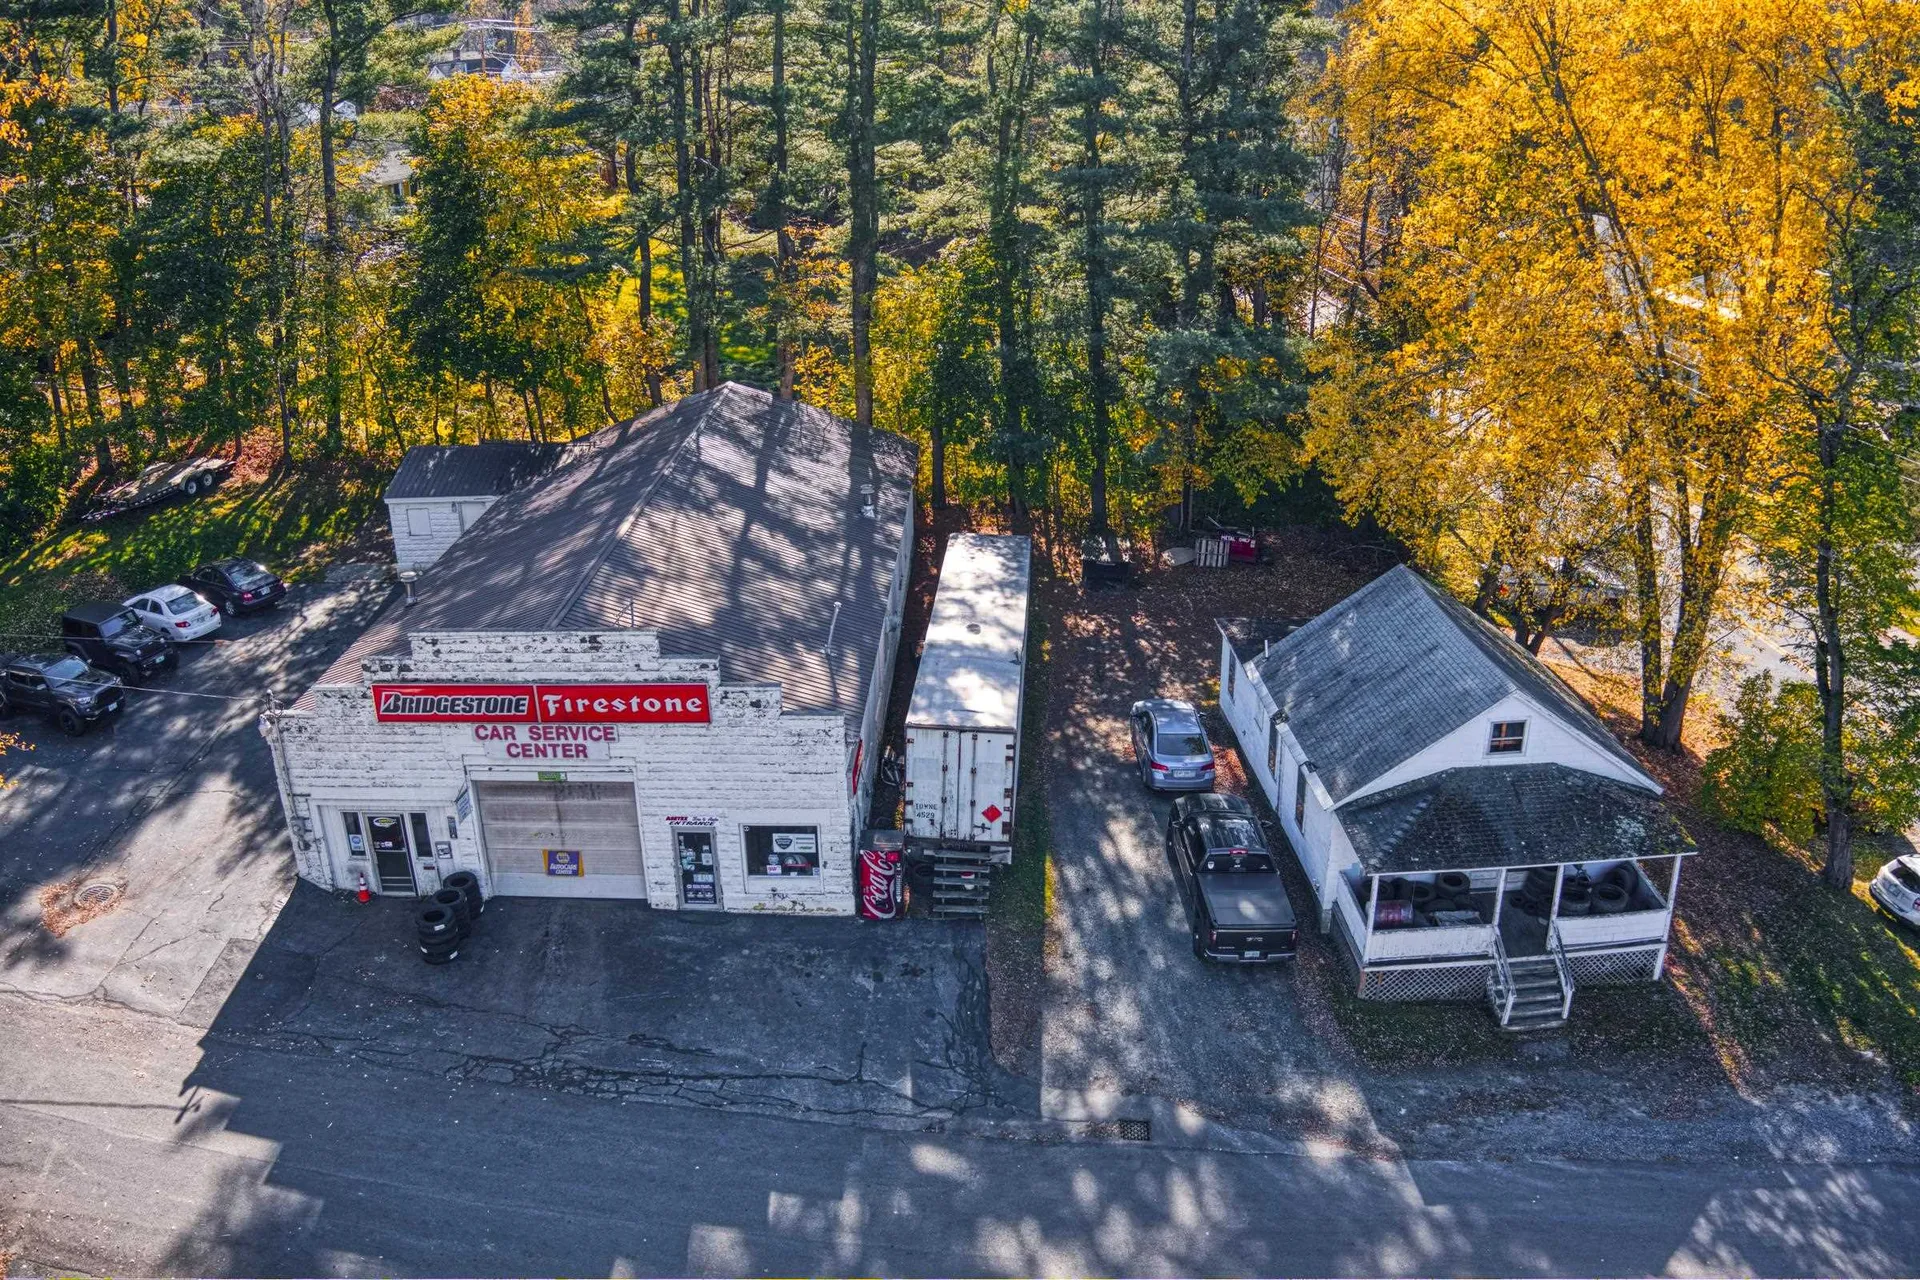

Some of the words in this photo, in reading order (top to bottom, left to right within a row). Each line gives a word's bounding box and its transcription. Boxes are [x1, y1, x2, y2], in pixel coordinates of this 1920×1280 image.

[380, 692, 529, 716] BRIDGESTONE
[542, 694, 703, 717] Firestone
[474, 725, 516, 741] CAR
[528, 725, 616, 742] SERVICE
[506, 743, 588, 759] CENTER
[916, 811, 935, 819] 4529
